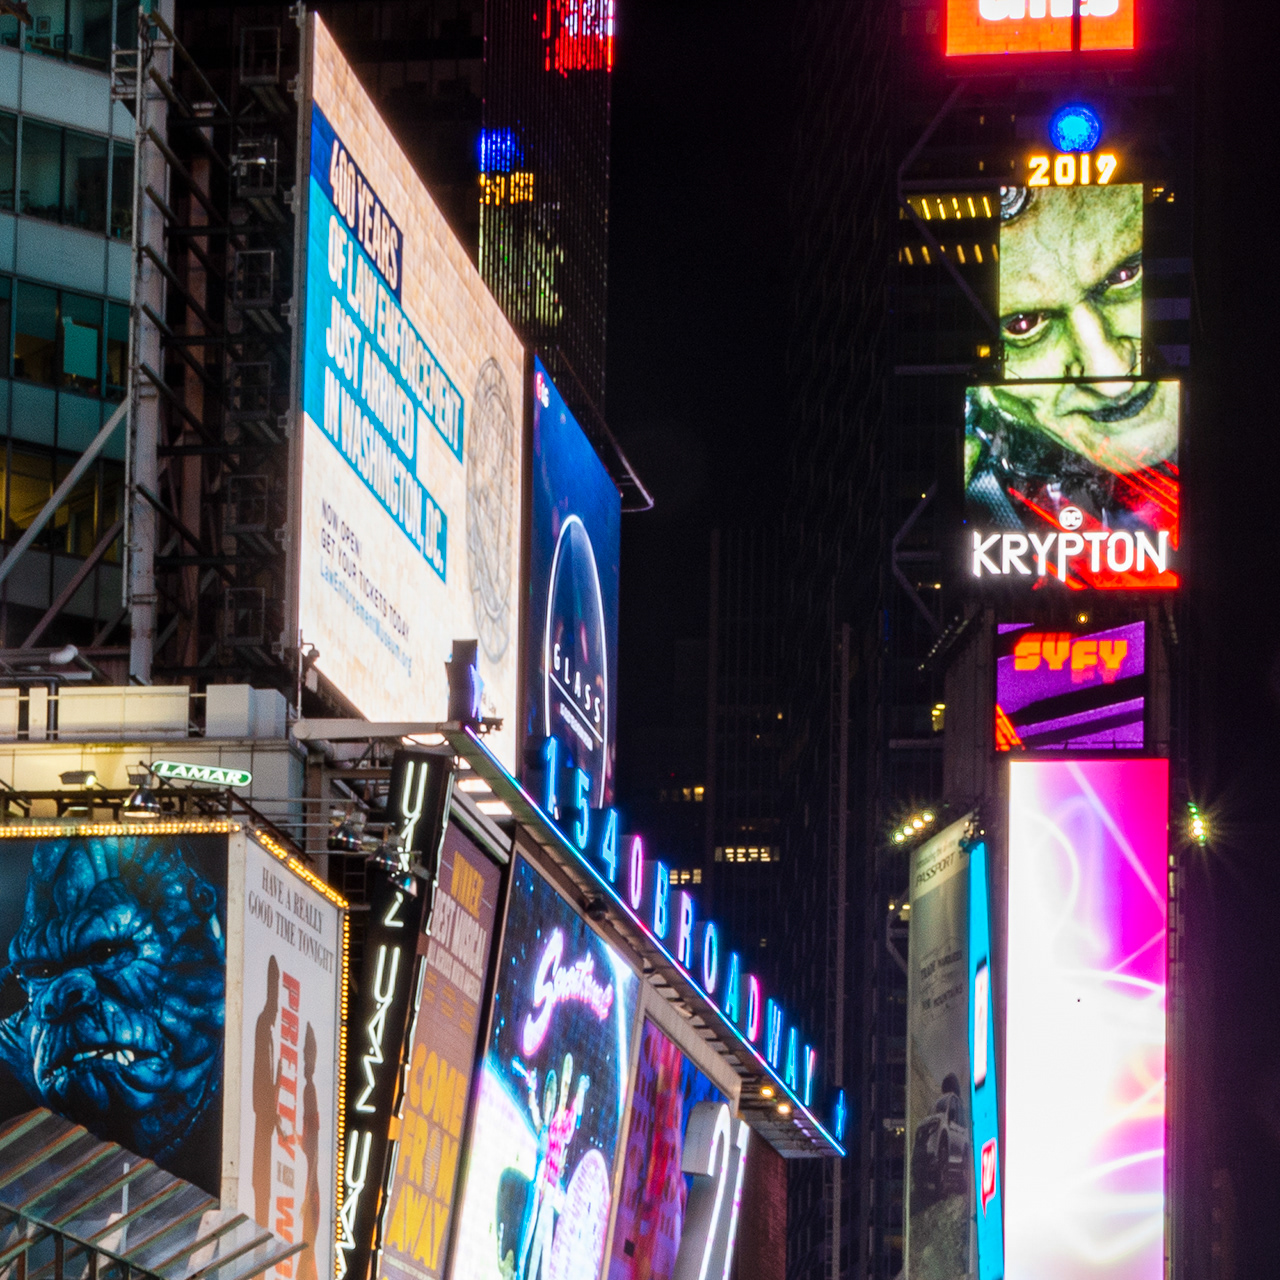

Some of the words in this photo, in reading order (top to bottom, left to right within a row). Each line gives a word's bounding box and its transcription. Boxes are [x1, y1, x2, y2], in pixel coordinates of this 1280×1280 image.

[1027, 153, 1118, 187] 2019
[329, 139, 356, 248] 400
[357, 174, 399, 291] YEARS
[328, 214, 348, 290] OF
[346, 245, 375, 335] LAW
[376, 286, 463, 452] ENFORCEMENT
[323, 365, 339, 445] IN
[325, 294, 362, 390] JUST
[361, 340, 415, 461] ARRIVED
[321, 497, 338, 534] NOW
[972, 530, 1170, 583] KRYPTON
[320, 527, 336, 560] GET
[337, 545, 357, 584] YOUR
[359, 570, 387, 618] TICKETS
[553, 642, 601, 724] GLASS
[1013, 634, 1128, 678] SYFY
[159, 762, 243, 784] LAMAR
[248, 889, 274, 929] GOOD
[275, 908, 296, 947] TIME
[298, 924, 334, 974] TONIGHT
[262, 866, 284, 906] HAVE
[284, 883, 293, 909] A
[293, 888, 324, 935] REALLY
[543, 735, 644, 911] 1540
[652, 860, 817, 1107] BROADWAY
[275, 970, 303, 1160] PRETTY
[409, 1042, 468, 1141] COME
[396, 1108, 460, 1206] FROM
[386, 1181, 450, 1271] AWAY
